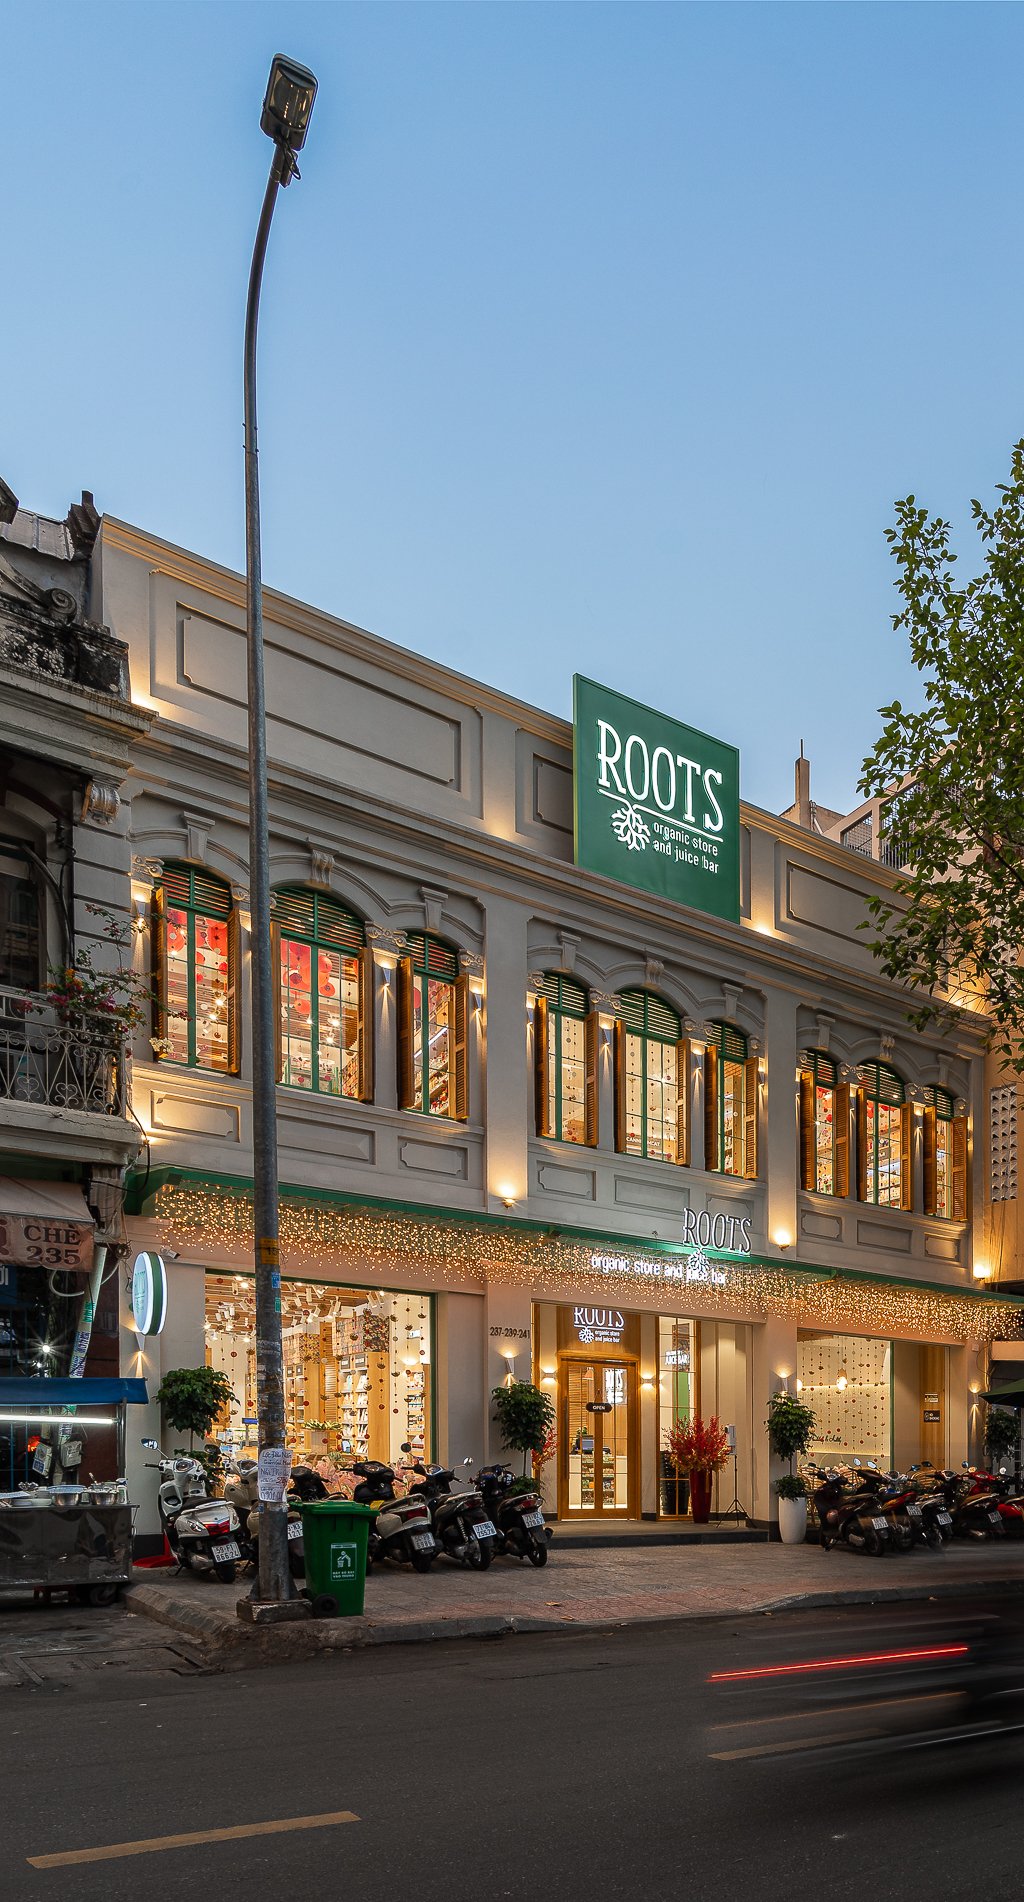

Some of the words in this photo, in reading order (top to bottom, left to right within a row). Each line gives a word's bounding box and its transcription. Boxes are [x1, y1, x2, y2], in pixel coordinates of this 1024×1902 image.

[597, 719, 723, 832] ROOTS
[653, 821, 689, 844] organic
[692, 836, 718, 856] store
[652, 839, 671, 856] and
[674, 846, 699, 866] juice
[702, 856, 719, 873] bar
[24, 1224, 81, 1245] CHÈ
[683, 1208, 752, 1254] ROOTS
[26, 1245, 81, 1265] 235
[591, 1255, 629, 1272] organic
[634, 1261, 660, 1275] store
[664, 1264, 682, 1278] and
[711, 1269, 725, 1284] bar
[574, 1307, 624, 1328] ROOTS
[489, 1327, 530, 1339] 237-239-241
